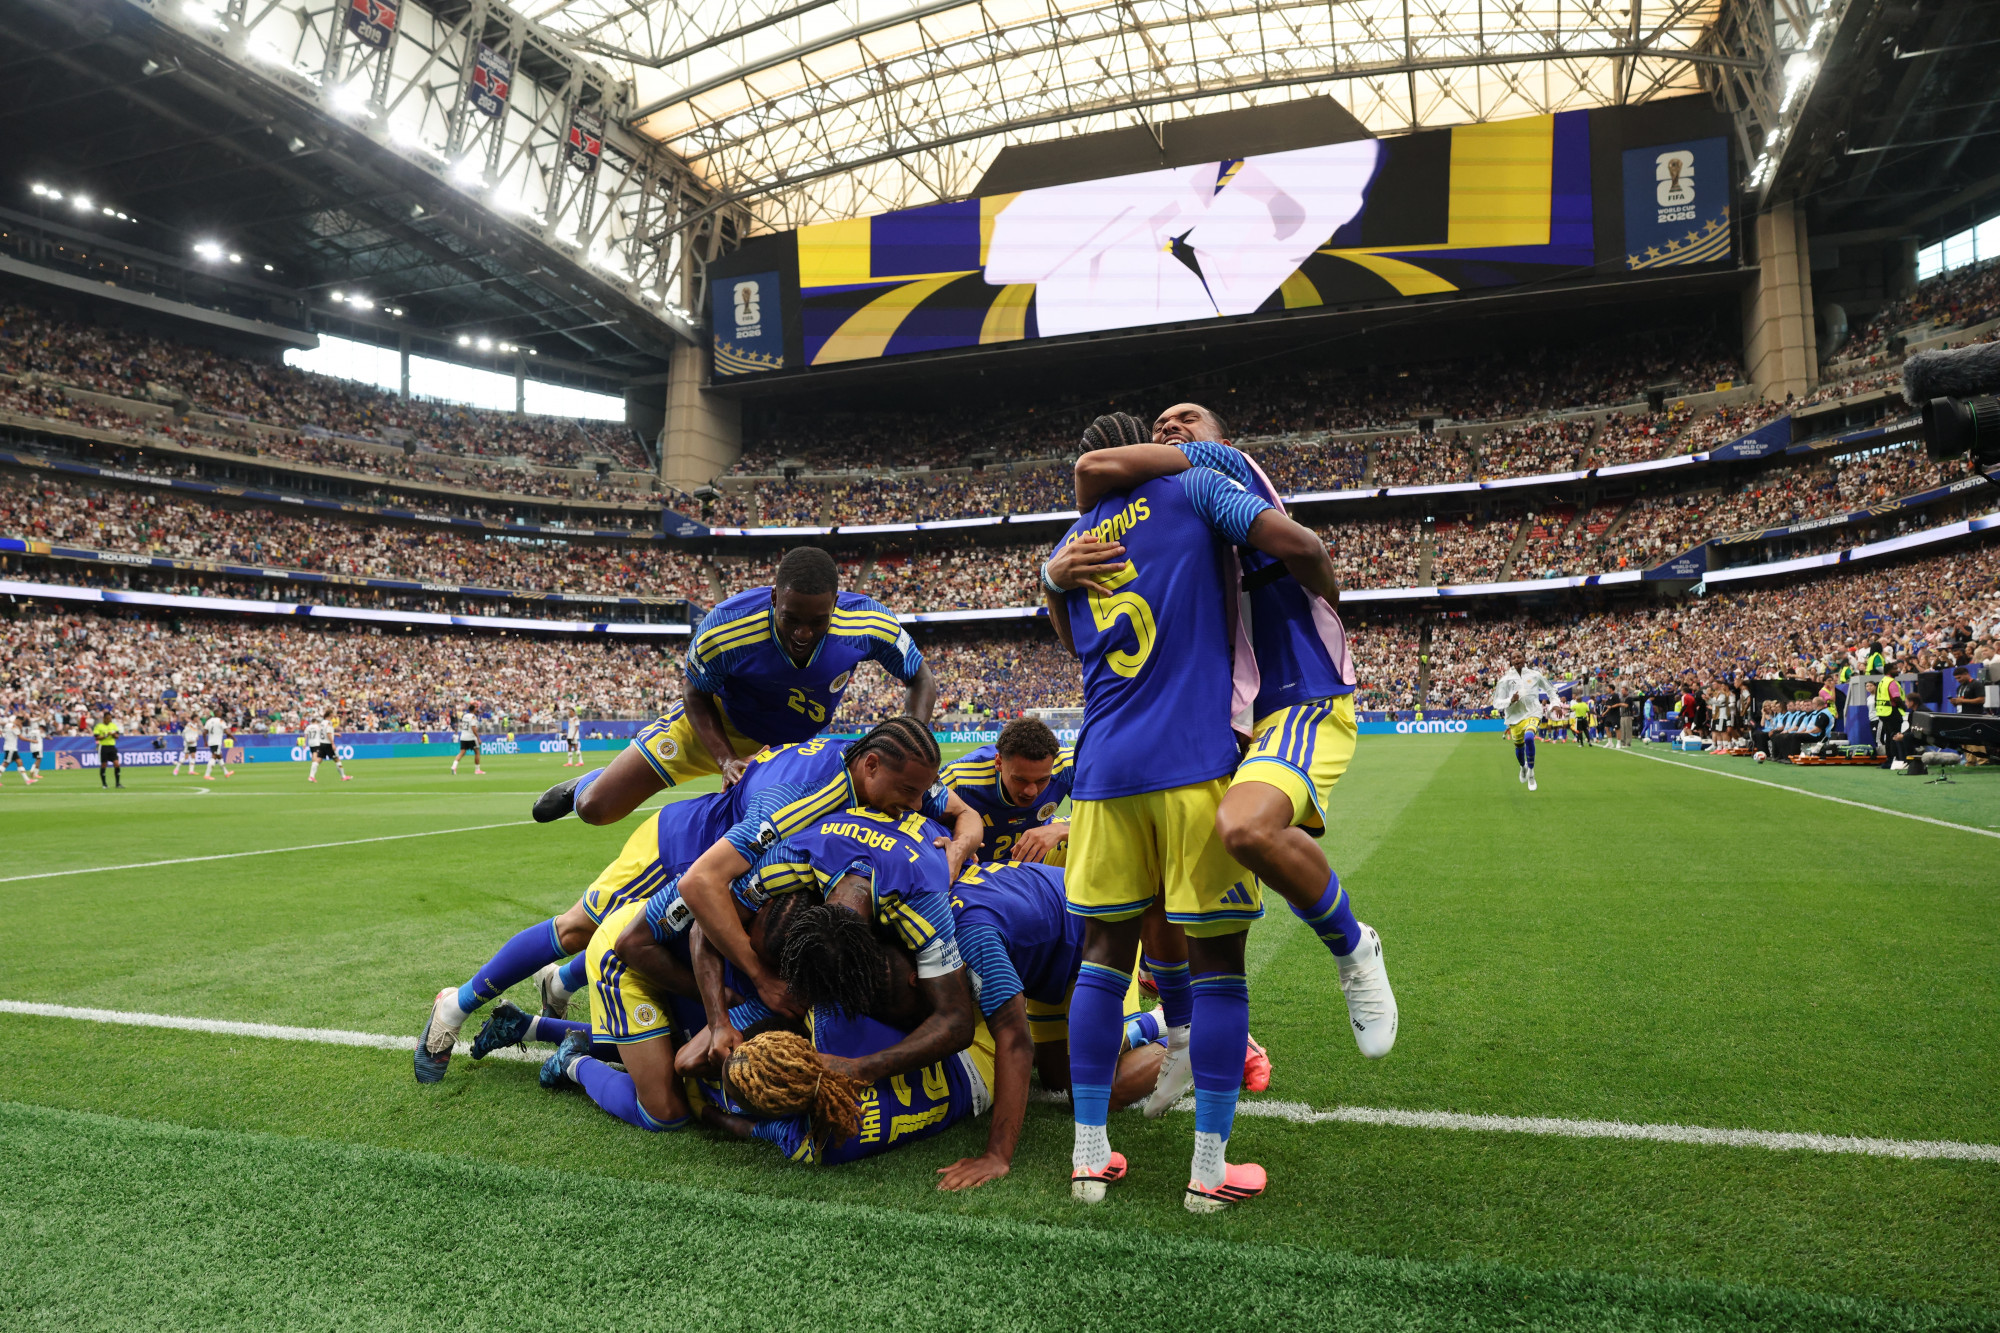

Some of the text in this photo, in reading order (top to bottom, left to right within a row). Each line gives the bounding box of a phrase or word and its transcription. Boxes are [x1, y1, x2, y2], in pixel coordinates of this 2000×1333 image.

[358, 21, 382, 44] 2019
[1657, 206, 1682, 215] WORLD
[1657, 211, 1696, 223] 2026
[1884, 424, 1898, 433] FIFA
[1898, 419, 1918, 430] WORLD
[415, 513, 451, 523] HOUSTON
[98, 553, 151, 565] HOUSTON
[421, 584, 460, 593] HOUSTON
[1087, 558, 1157, 678] 5
[787, 688, 826, 723] 23
[1396, 720, 1468, 734] aramco
[951, 731, 998, 743] PARTNER
[291, 745, 354, 761] arco
[481, 741, 518, 754] PARTNER
[123, 751, 161, 765] STATES
[163, 750, 178, 763] OF
[820, 822, 920, 863] L. BACUNA
